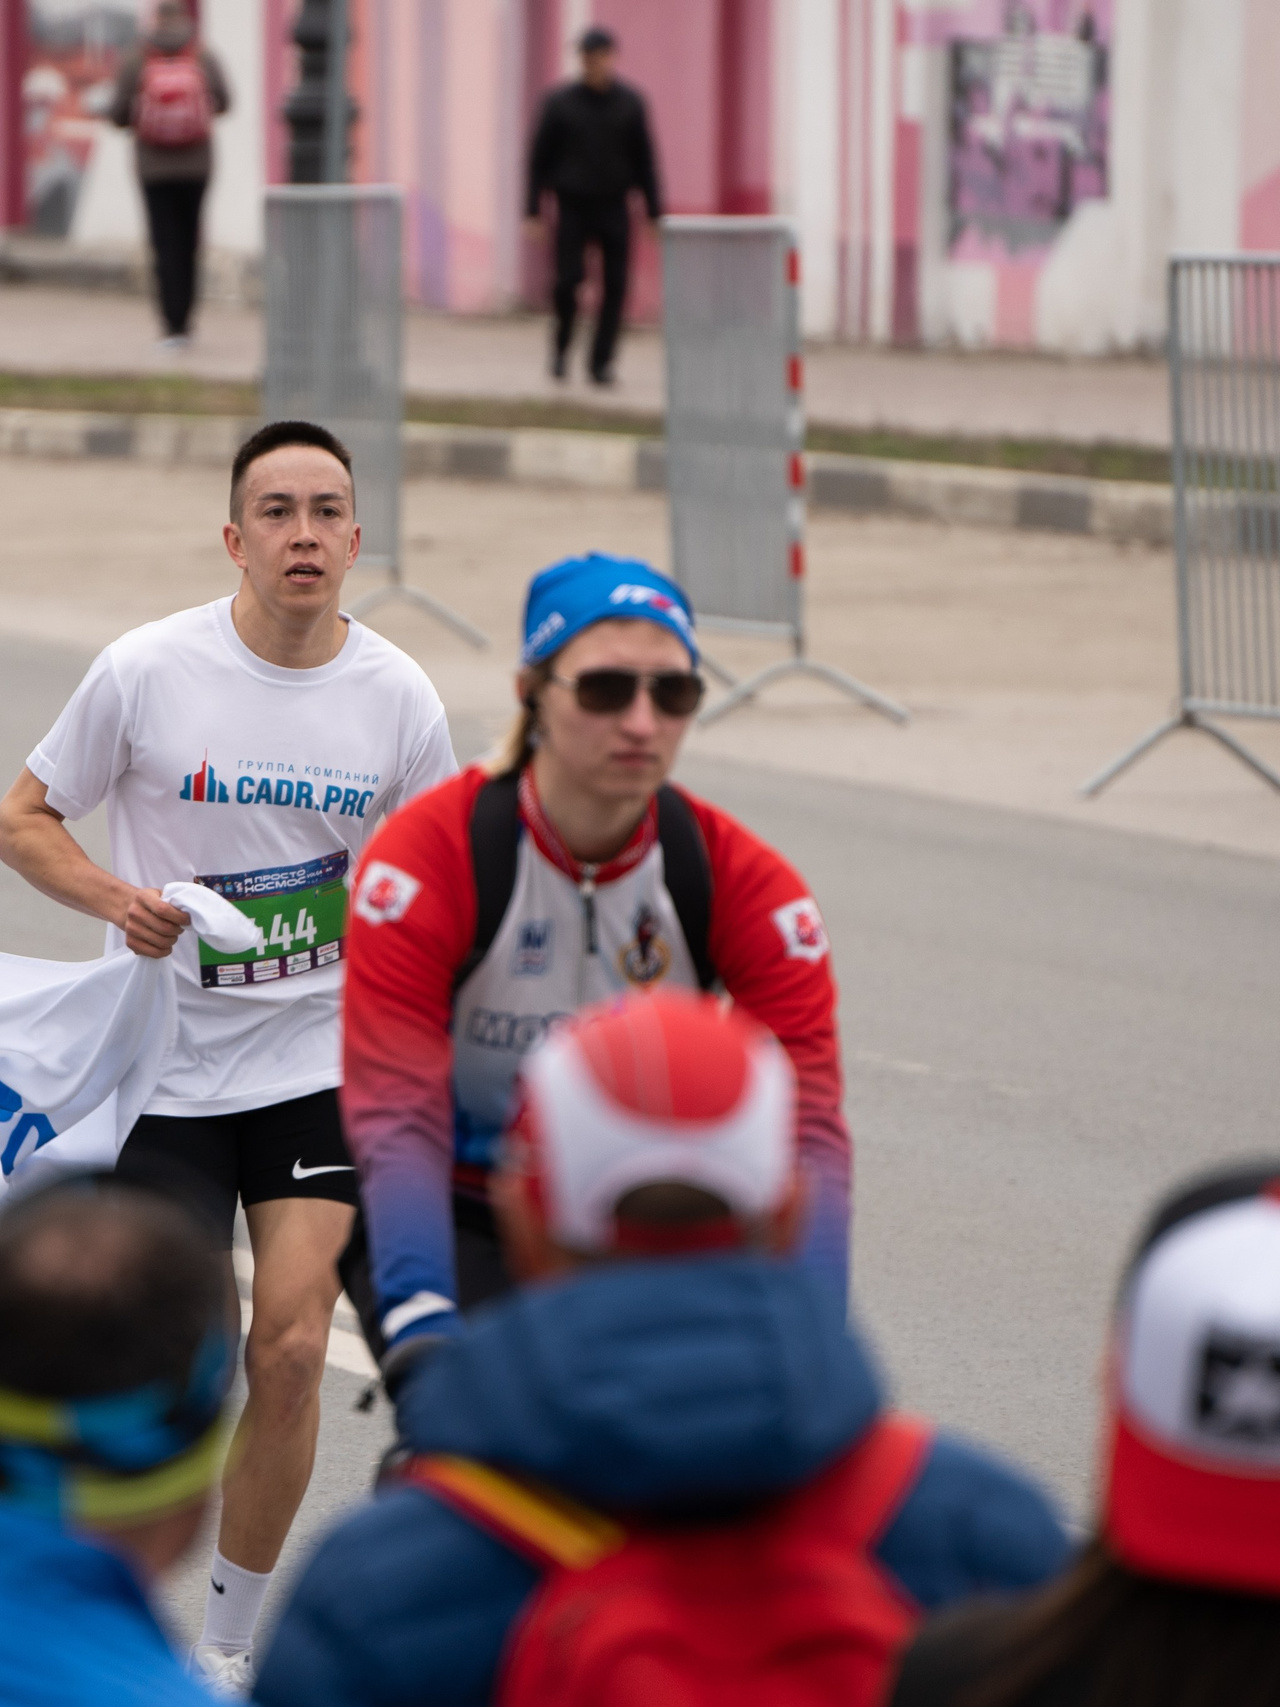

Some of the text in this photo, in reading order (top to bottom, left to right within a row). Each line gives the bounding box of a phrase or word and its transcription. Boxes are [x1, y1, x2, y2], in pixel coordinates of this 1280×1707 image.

[238, 760, 380, 785] ГРУППА КОМПАНИЙ
[244, 877, 253, 885] Я
[254, 869, 306, 882] ПРОСТО
[245, 876, 307, 893] КОСМОС
